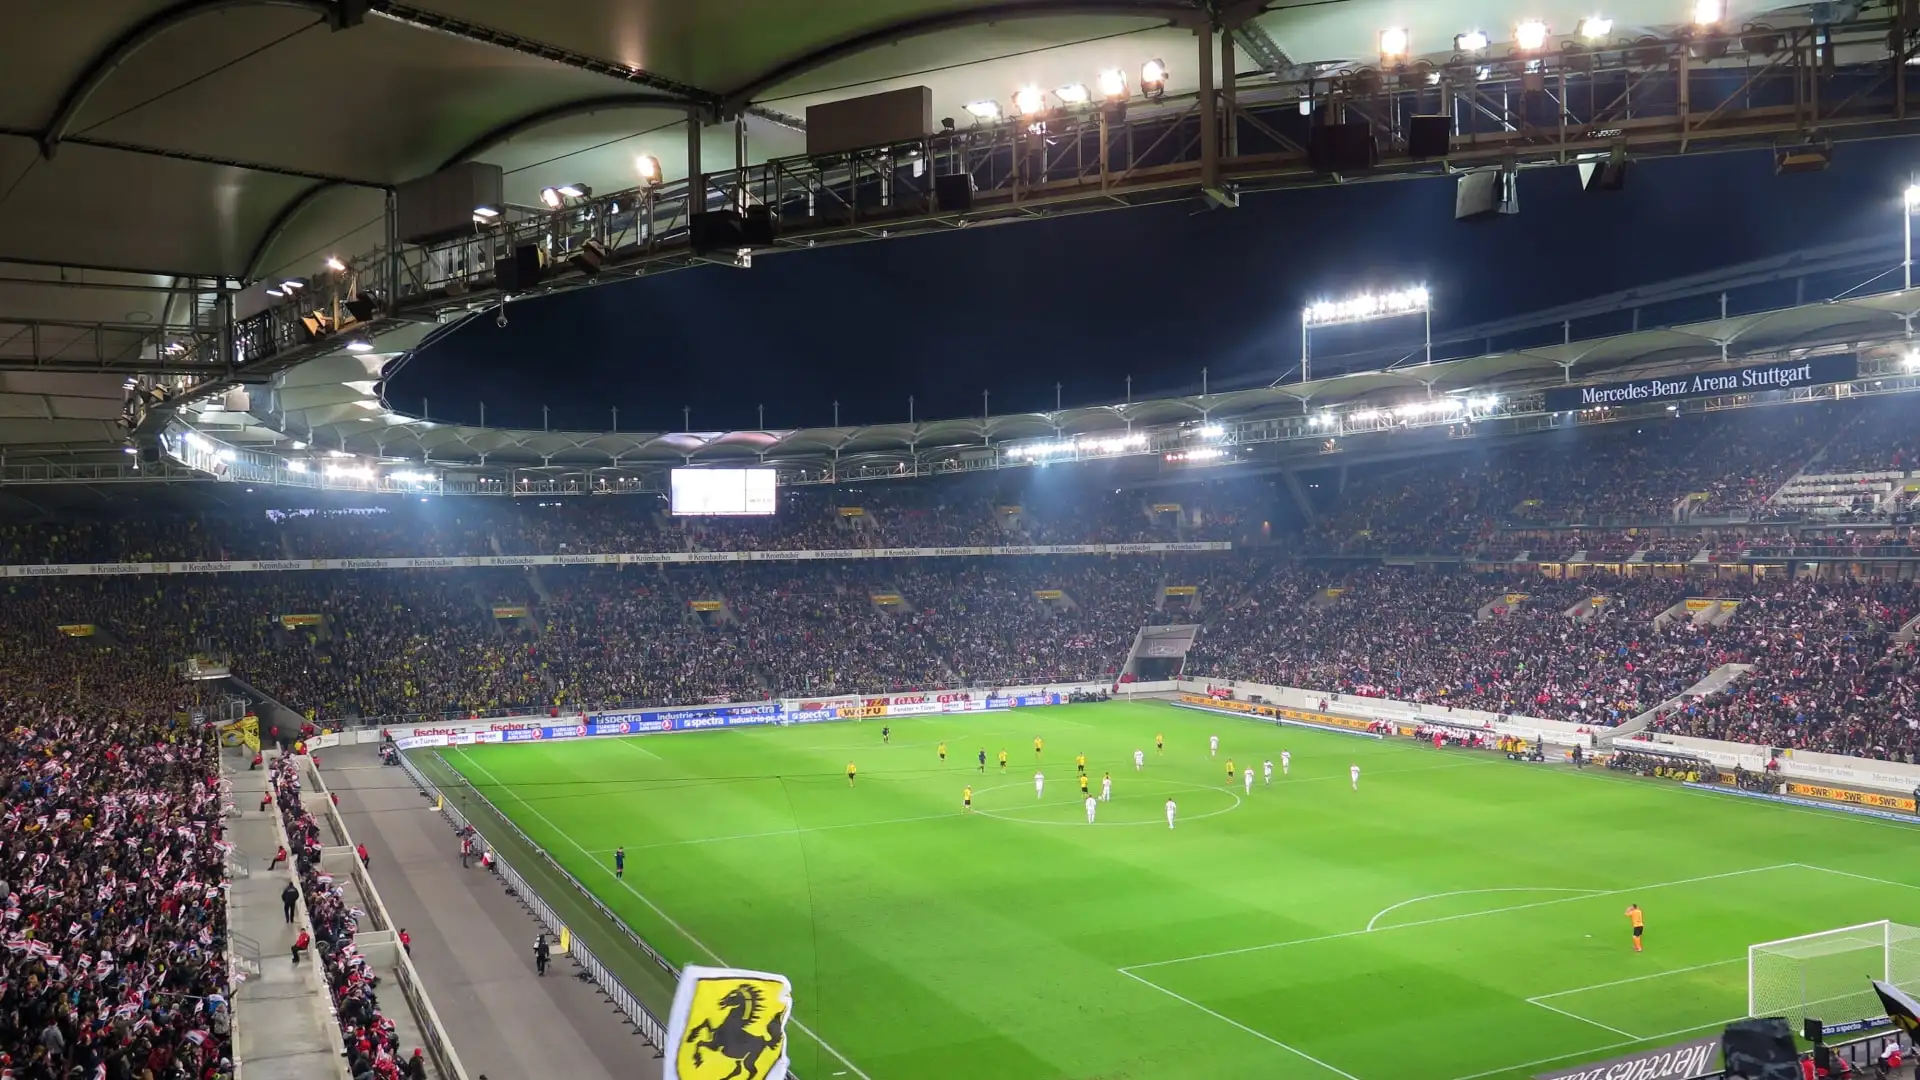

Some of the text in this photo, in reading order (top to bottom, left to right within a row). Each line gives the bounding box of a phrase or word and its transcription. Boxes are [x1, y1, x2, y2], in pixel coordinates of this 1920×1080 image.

[1582, 363, 1812, 404] Mercedes-Benz Arena Stuttgart
[497, 557, 534, 565] Krombacher
[559, 555, 596, 563] Krombacher
[188, 563, 231, 571] Krombacher
[259, 562, 300, 570] Krombacher
[348, 560, 388, 568] Krombacher
[26, 567, 69, 575] Krombacher
[97, 565, 139, 573] Krombacher
[798, 710, 830, 720] spectra
[844, 707, 881, 717] weru
[605, 713, 642, 724] spectra
[691, 716, 724, 728] spectra
[490, 723, 525, 731] fischer
[414, 728, 450, 736] fischer
